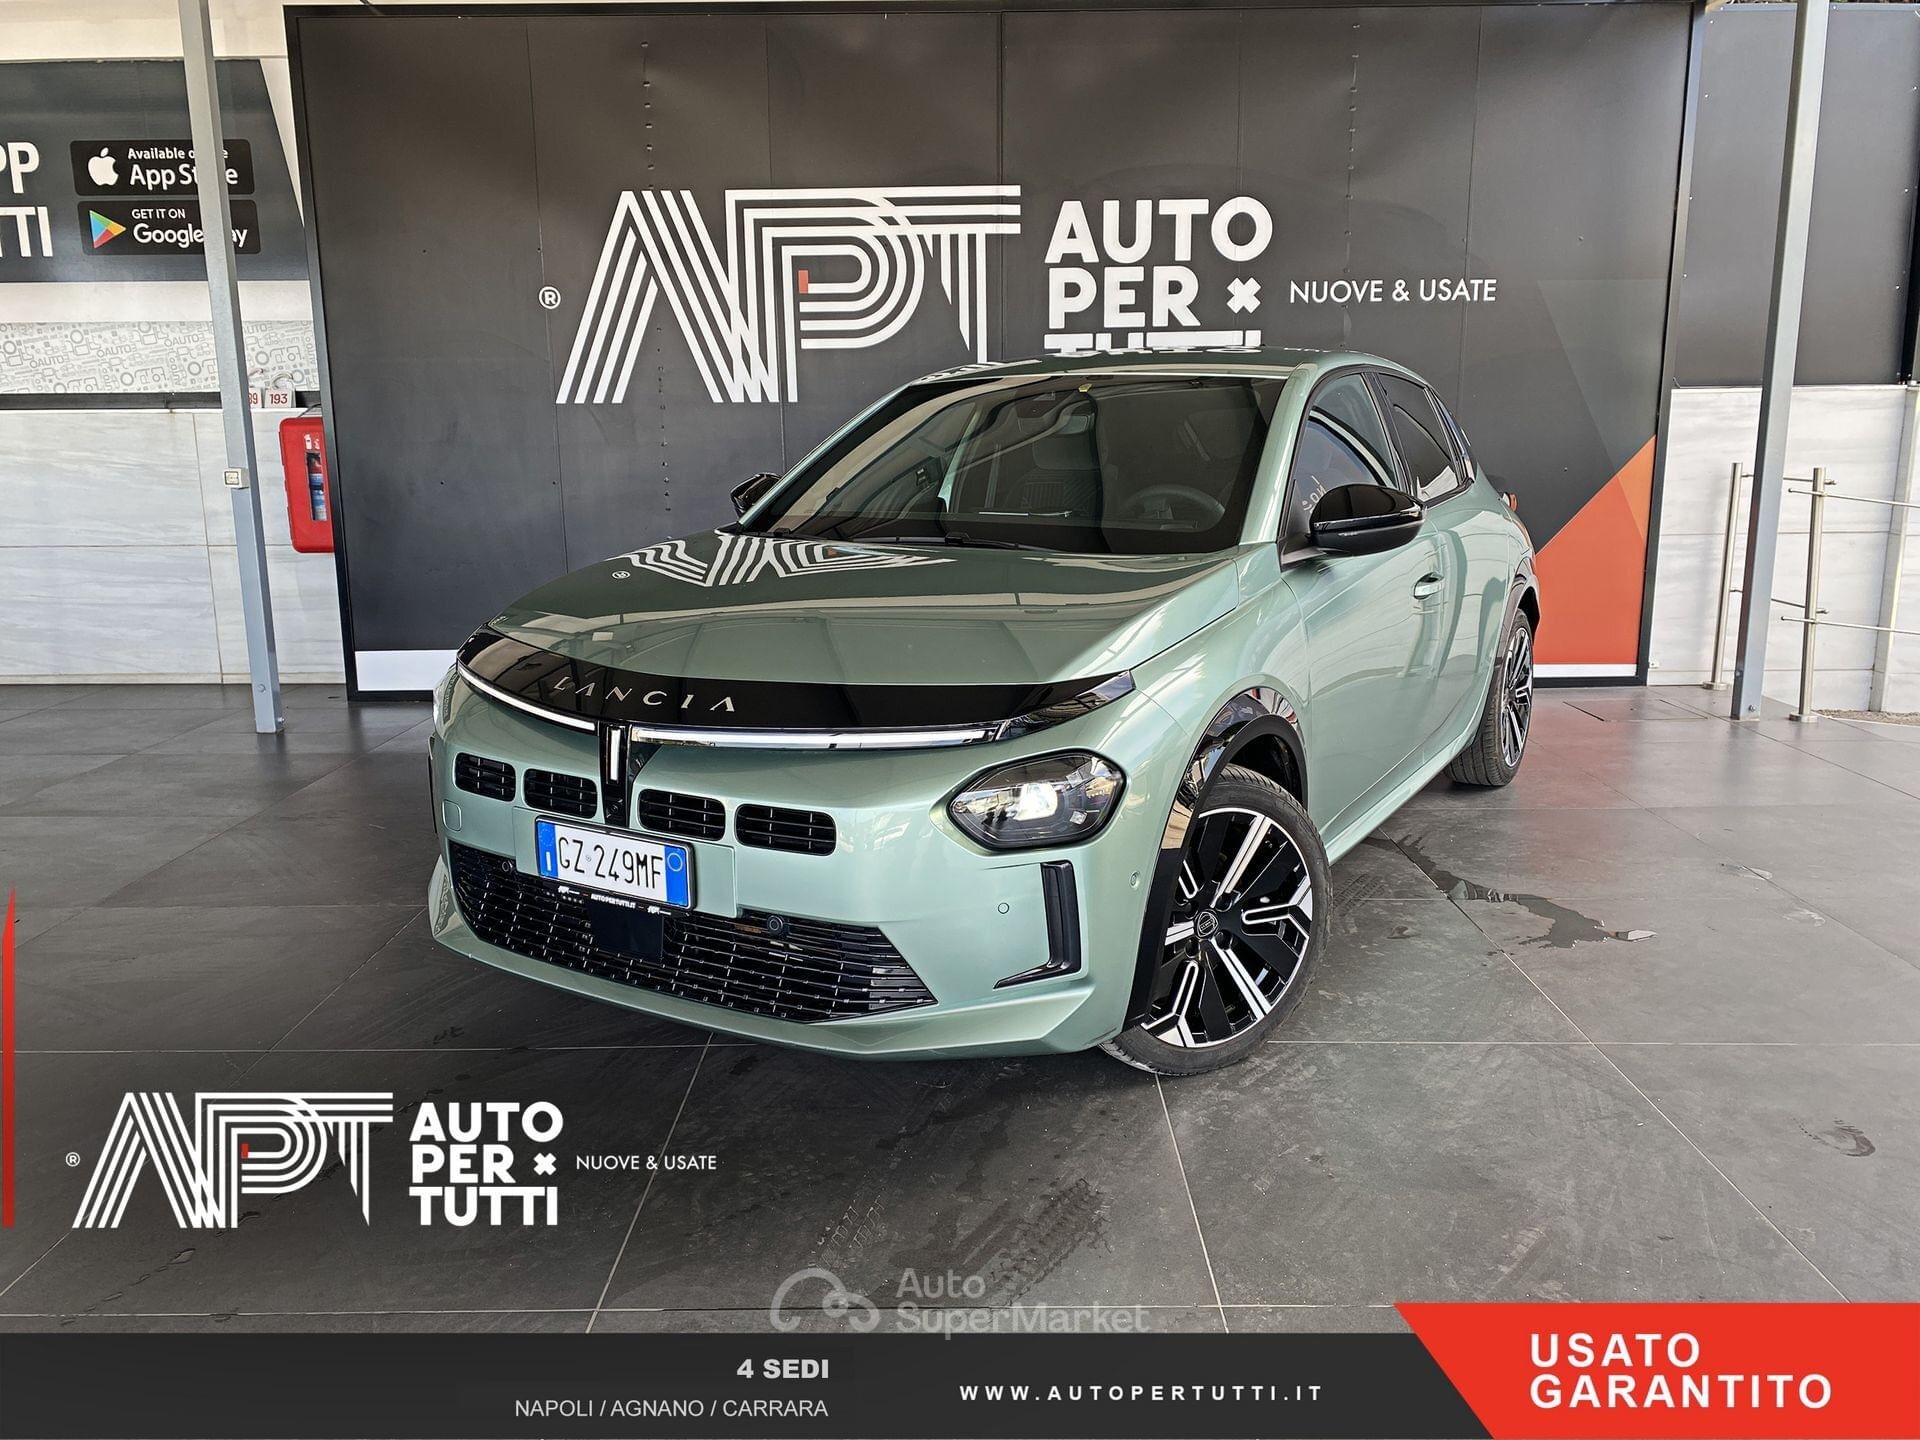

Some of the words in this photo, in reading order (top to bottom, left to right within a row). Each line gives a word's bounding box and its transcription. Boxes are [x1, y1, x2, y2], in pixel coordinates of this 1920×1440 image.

[127, 147, 185, 160] Available
[129, 163, 176, 191] App
[178, 163, 238, 185] Ste
[131, 208, 153, 219] GET
[156, 208, 166, 219] IT
[168, 208, 186, 219] ON
[133, 222, 205, 248] Google
[1044, 196, 1273, 264] AUTO
[1048, 265, 1201, 329] PER
[1289, 279, 1384, 304] NUOVE
[1391, 279, 1410, 302] &
[1419, 278, 1497, 302] USATE
[269, 394, 288, 405] 193
[553, 675, 735, 713] LANCIA
[558, 837, 585, 873] GZ
[593, 844, 663, 889] 249MF
